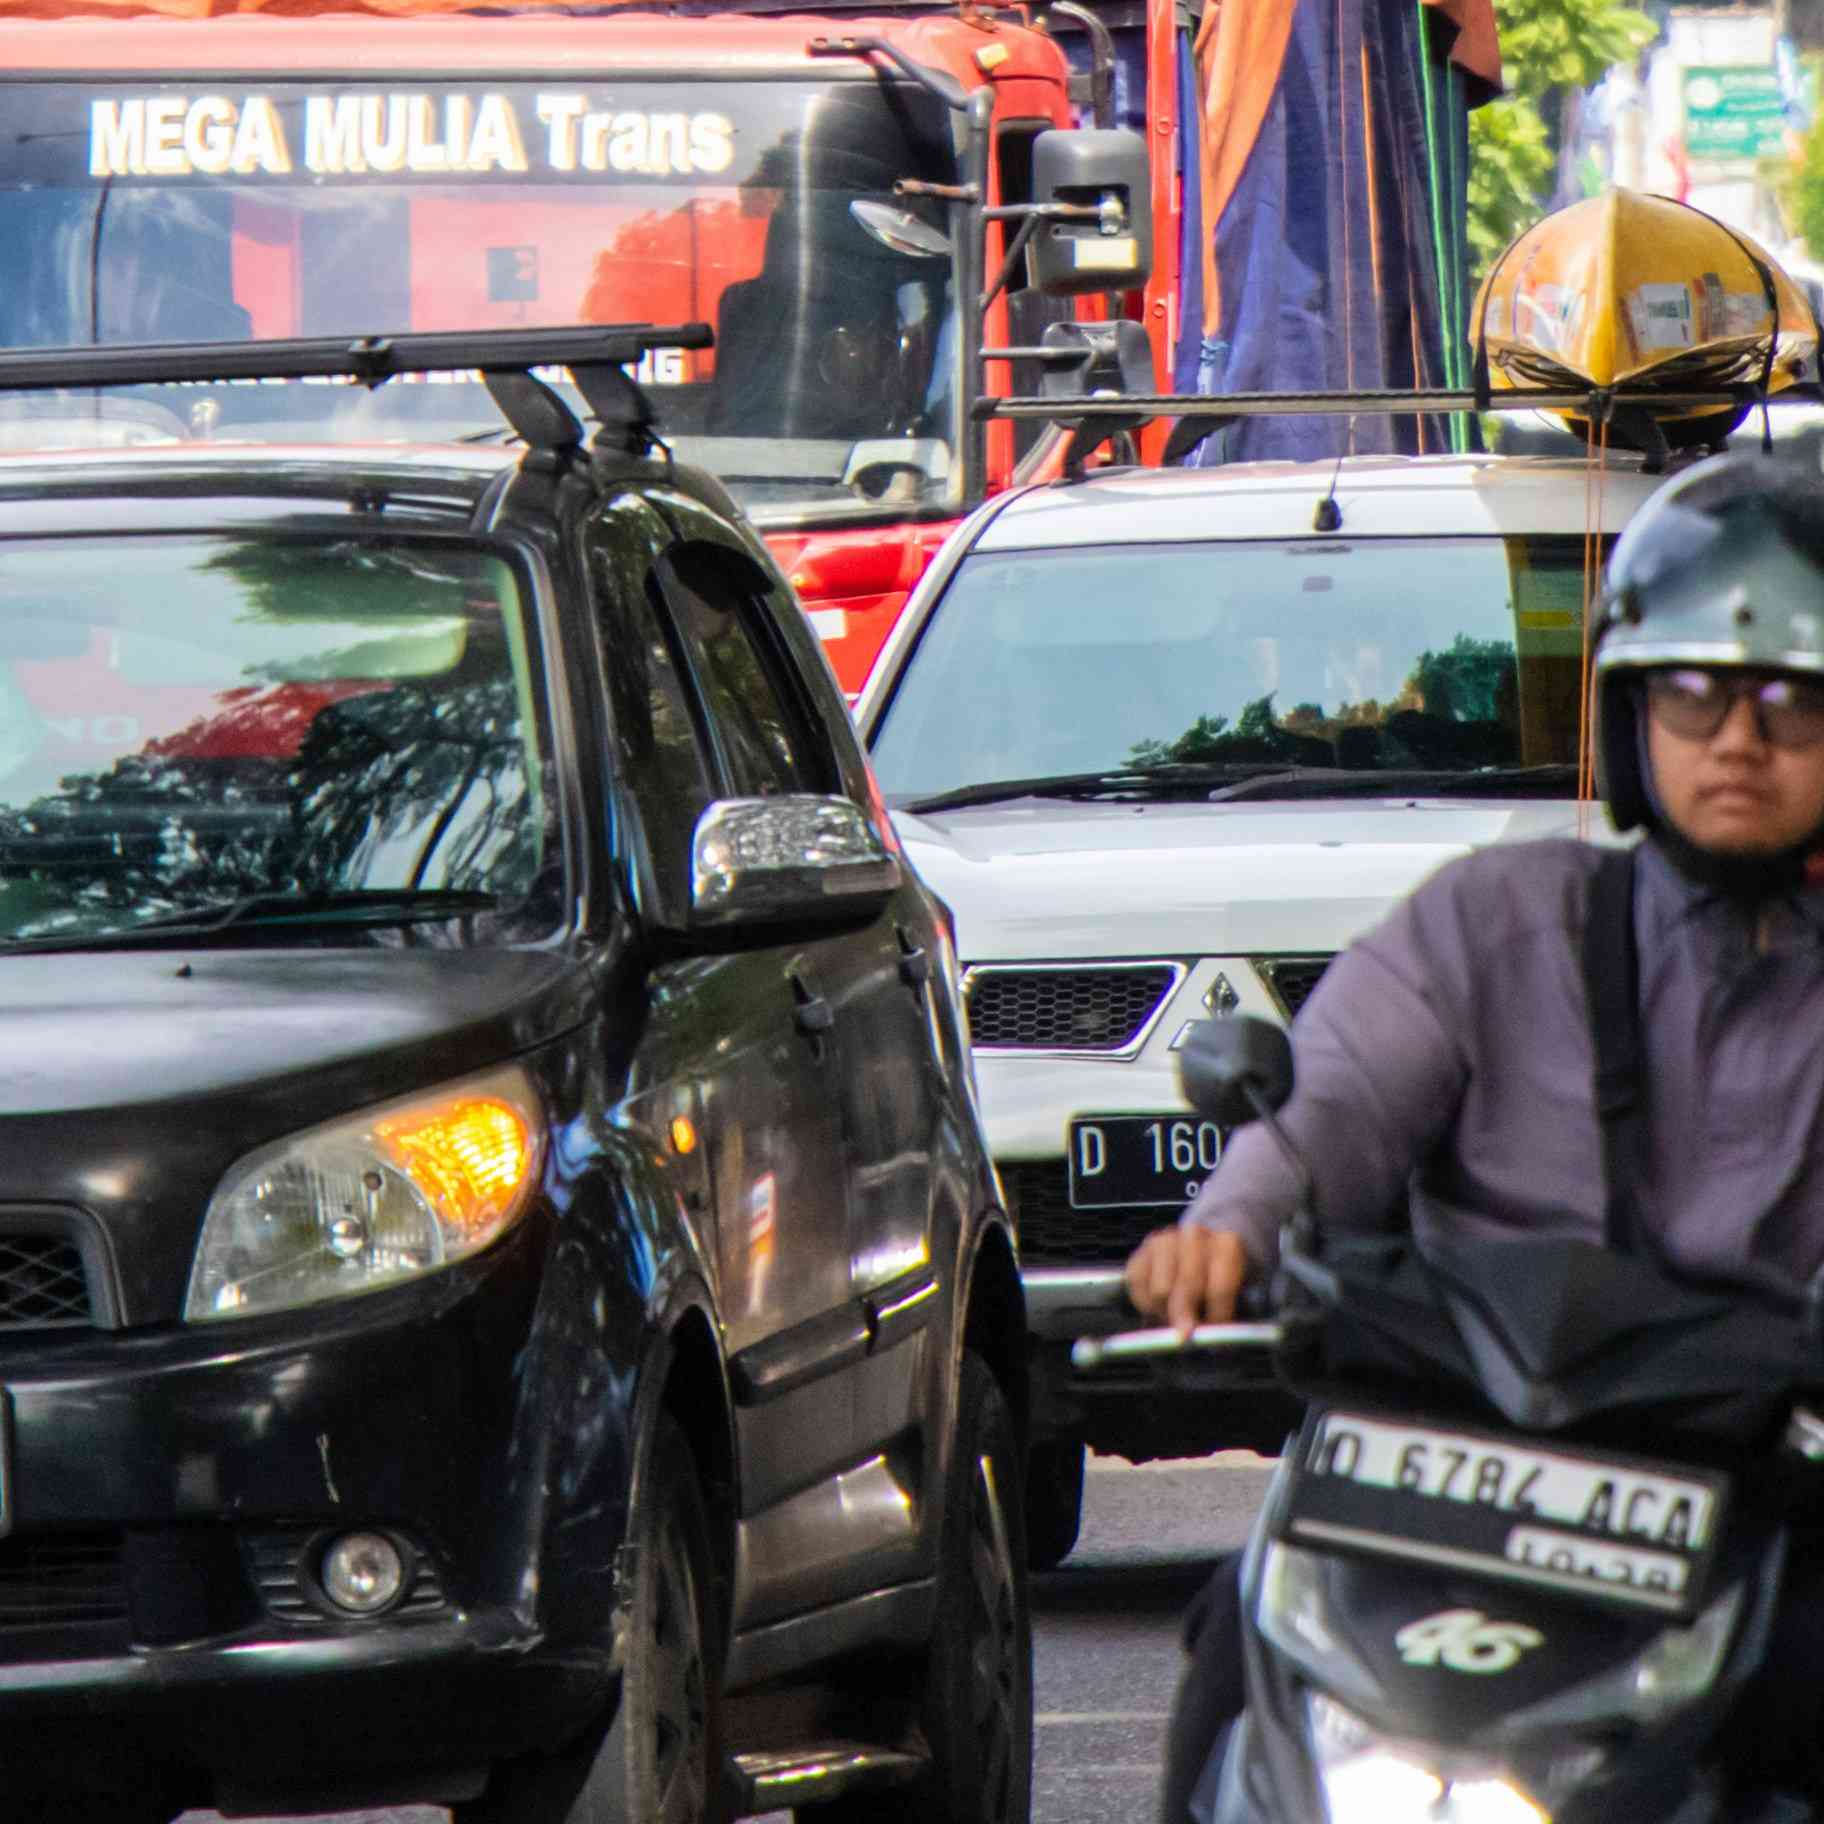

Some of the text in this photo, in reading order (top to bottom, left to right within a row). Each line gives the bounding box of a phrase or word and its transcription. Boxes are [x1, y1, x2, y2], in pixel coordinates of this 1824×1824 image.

[90, 94, 736, 175] MEGA MULIA Trans
[1079, 1126, 1106, 1176] D
